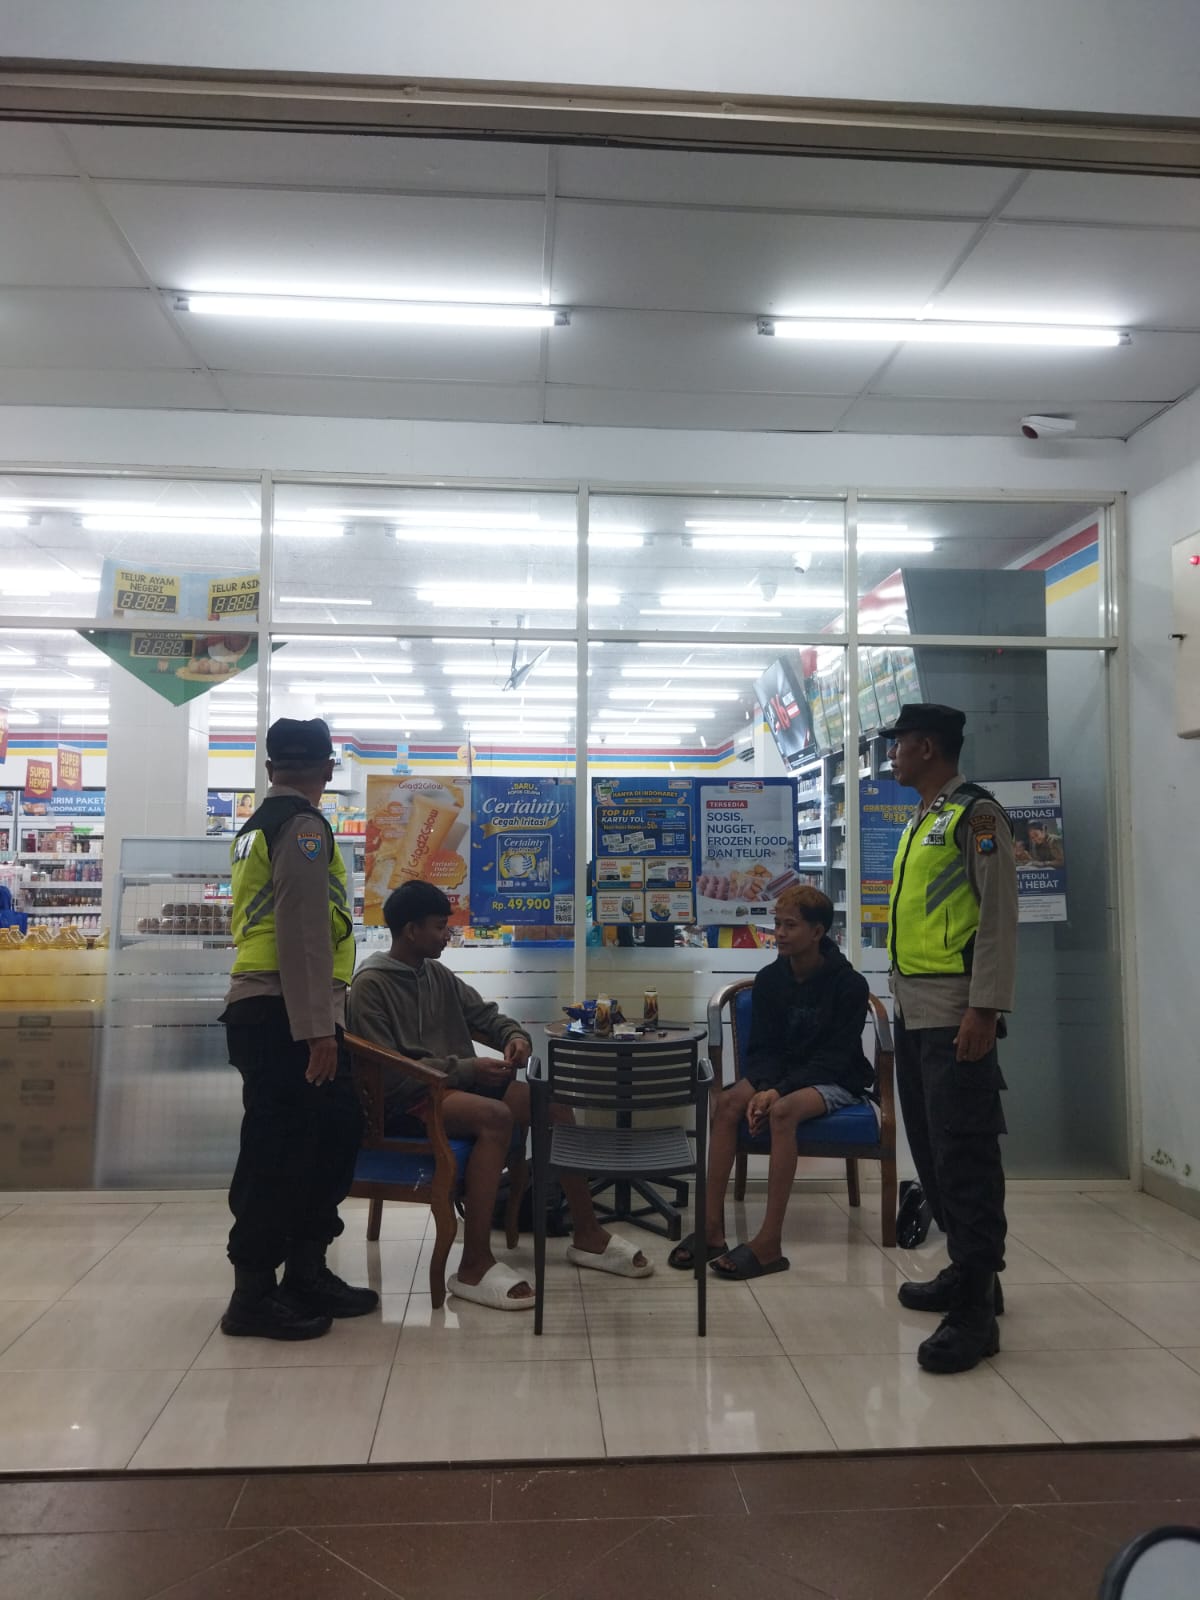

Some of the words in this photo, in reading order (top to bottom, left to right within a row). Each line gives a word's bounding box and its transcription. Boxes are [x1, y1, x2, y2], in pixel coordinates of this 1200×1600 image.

[120, 571, 146, 583] TELUR
[149, 576, 175, 587] AYAM
[129, 583, 164, 594] NEGERI
[211, 582, 238, 594] TELUR
[61, 751, 80, 767] SUPER
[30, 766, 50, 779] SUPER
[60, 765, 79, 778] HEMAT
[29, 777, 50, 789] HEMAT
[398, 782, 443, 790] Glad2Glow
[482, 797, 564, 818] Certainty
[601, 809, 620, 817] TOP
[622, 809, 636, 817] UP
[706, 812, 743, 822] SOSIS,
[1007, 809, 1055, 819] RDONASI
[492, 817, 519, 827] Cegah
[521, 816, 548, 826] Iritasi
[707, 824, 756, 835] NUGGET,
[408, 809, 439, 868] Glad2Glow
[503, 838, 545, 848] Certainty
[707, 836, 751, 846] FROZEN
[707, 848, 733, 858] DAN
[1022, 872, 1049, 880] PEDULI
[1025, 879, 1059, 889] HEBAT
[507, 898, 551, 911] 49,900
